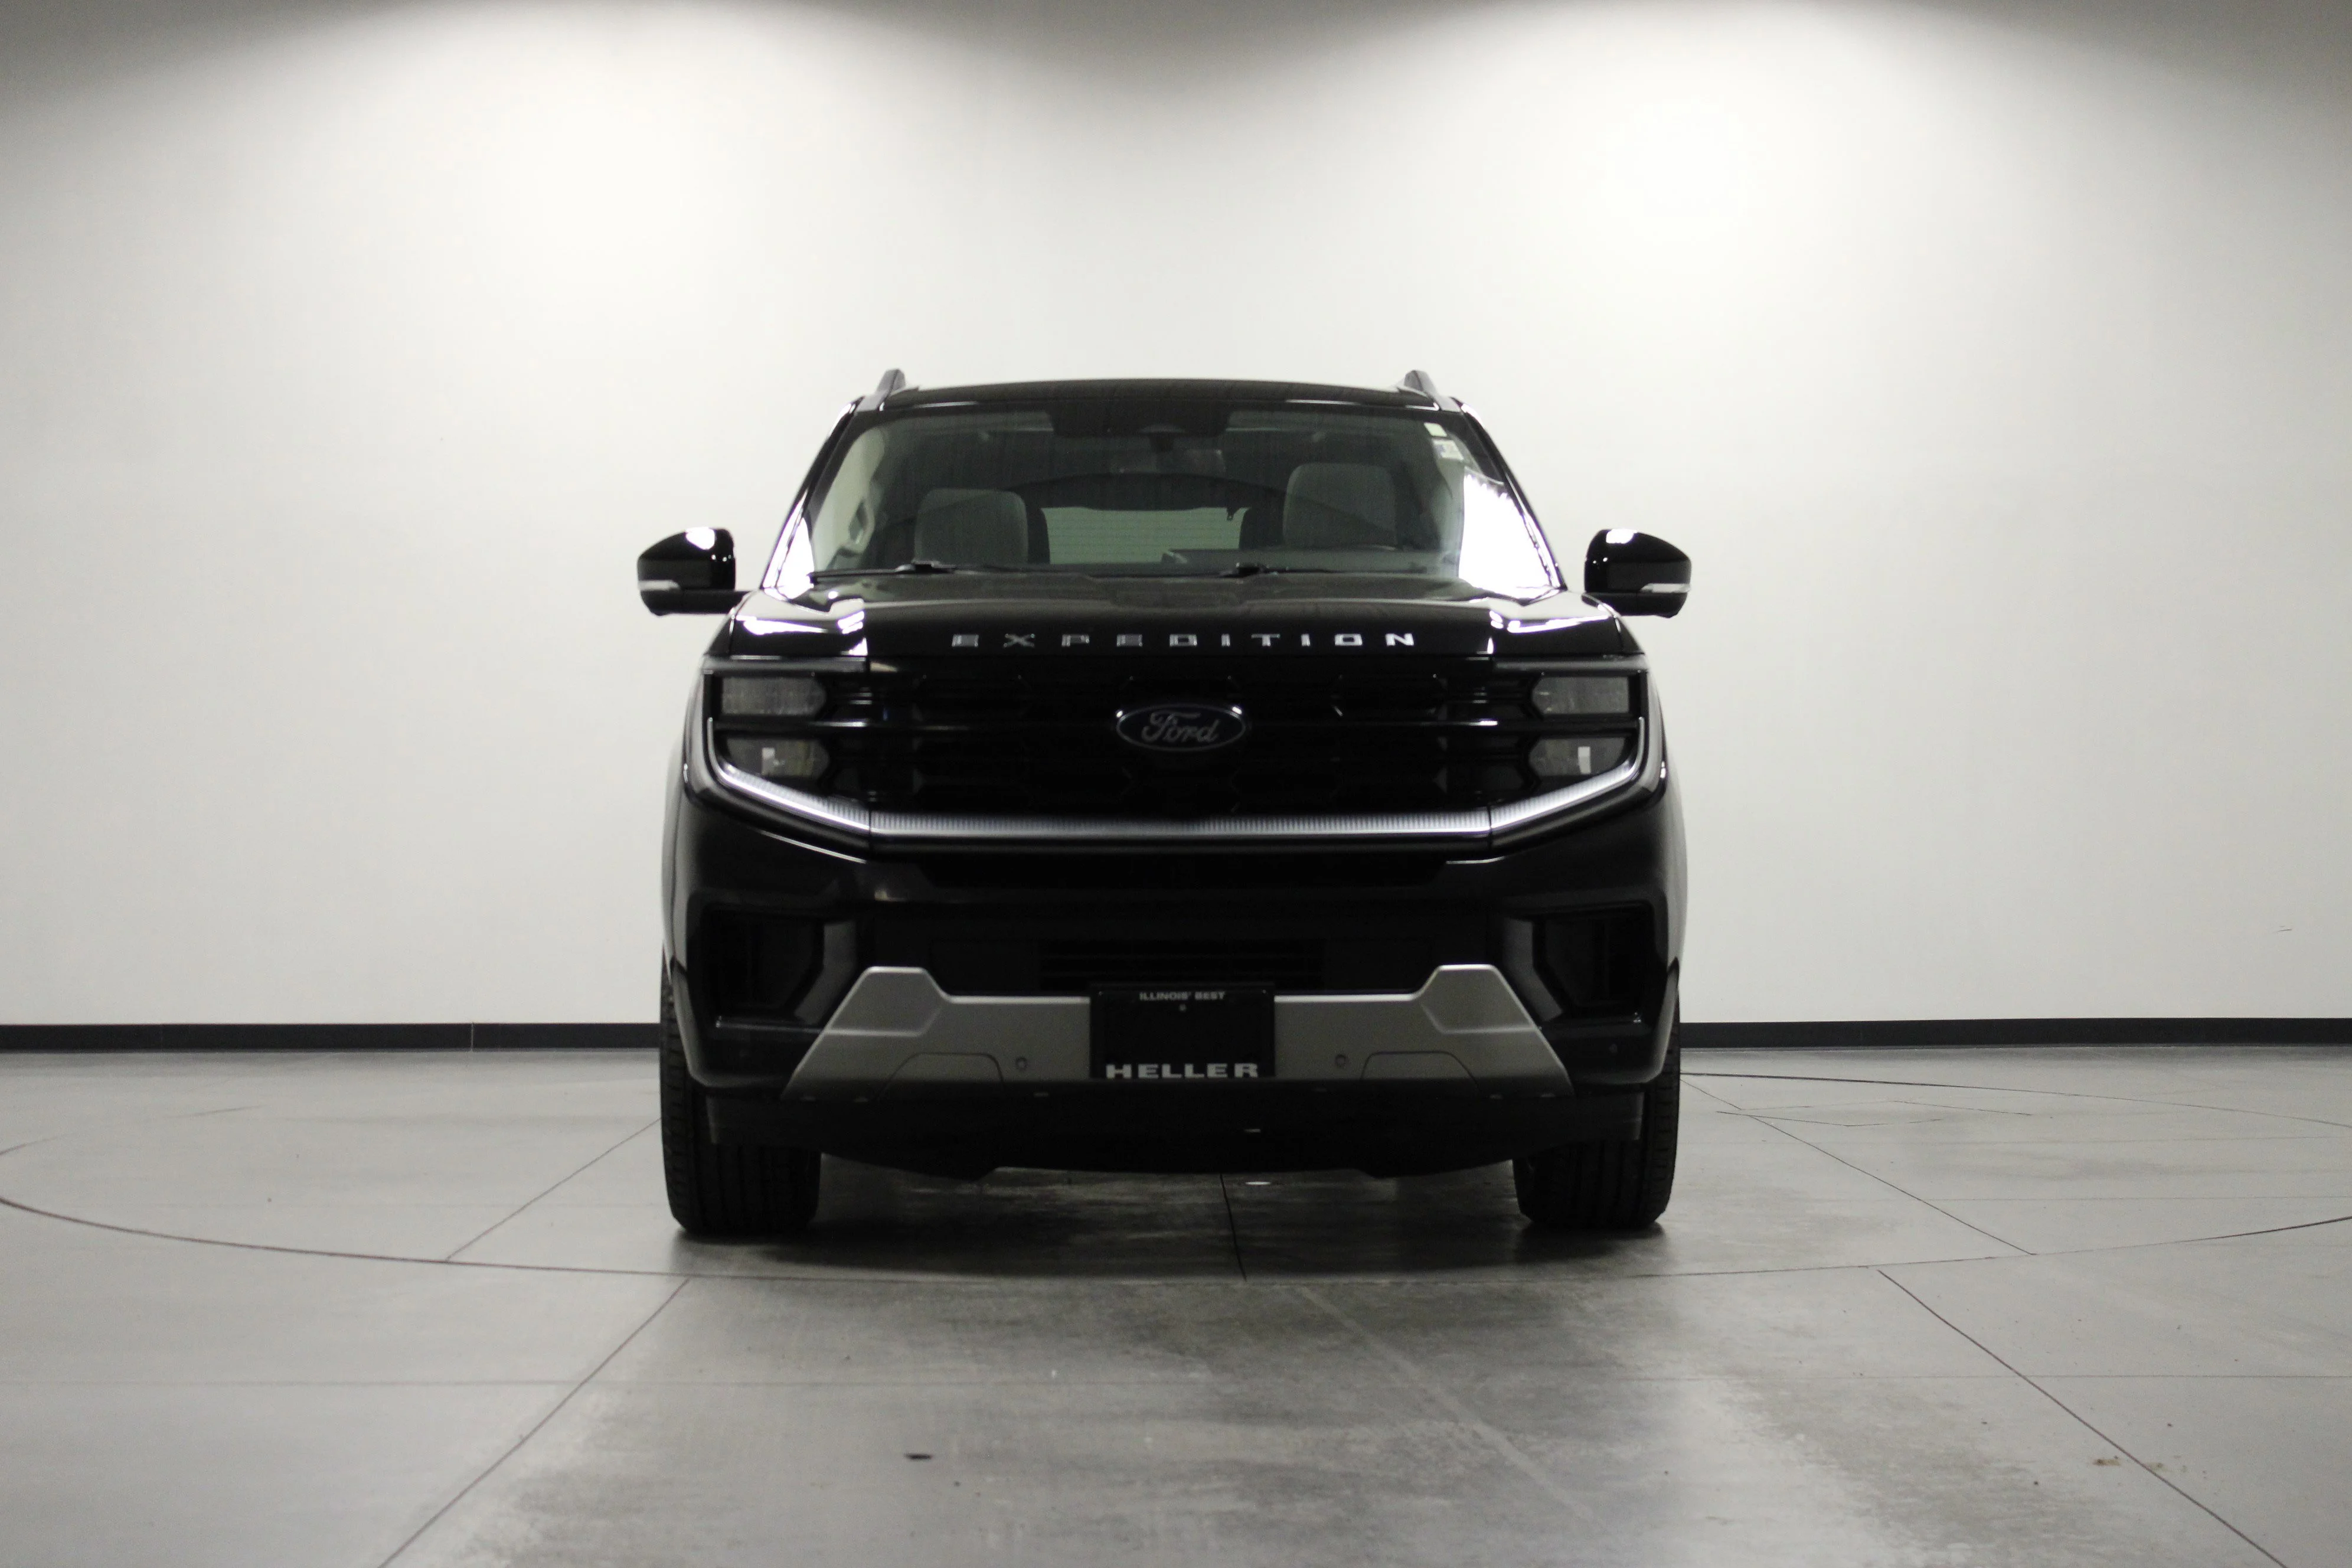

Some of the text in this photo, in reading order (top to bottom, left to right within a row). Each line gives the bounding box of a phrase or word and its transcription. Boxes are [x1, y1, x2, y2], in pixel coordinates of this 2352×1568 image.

[952, 632, 1415, 646] EXPEDITION
[1141, 710, 1220, 742] Ford
[1194, 991, 1226, 1001] BEST
[1105, 1063, 1259, 1079] HELLER
